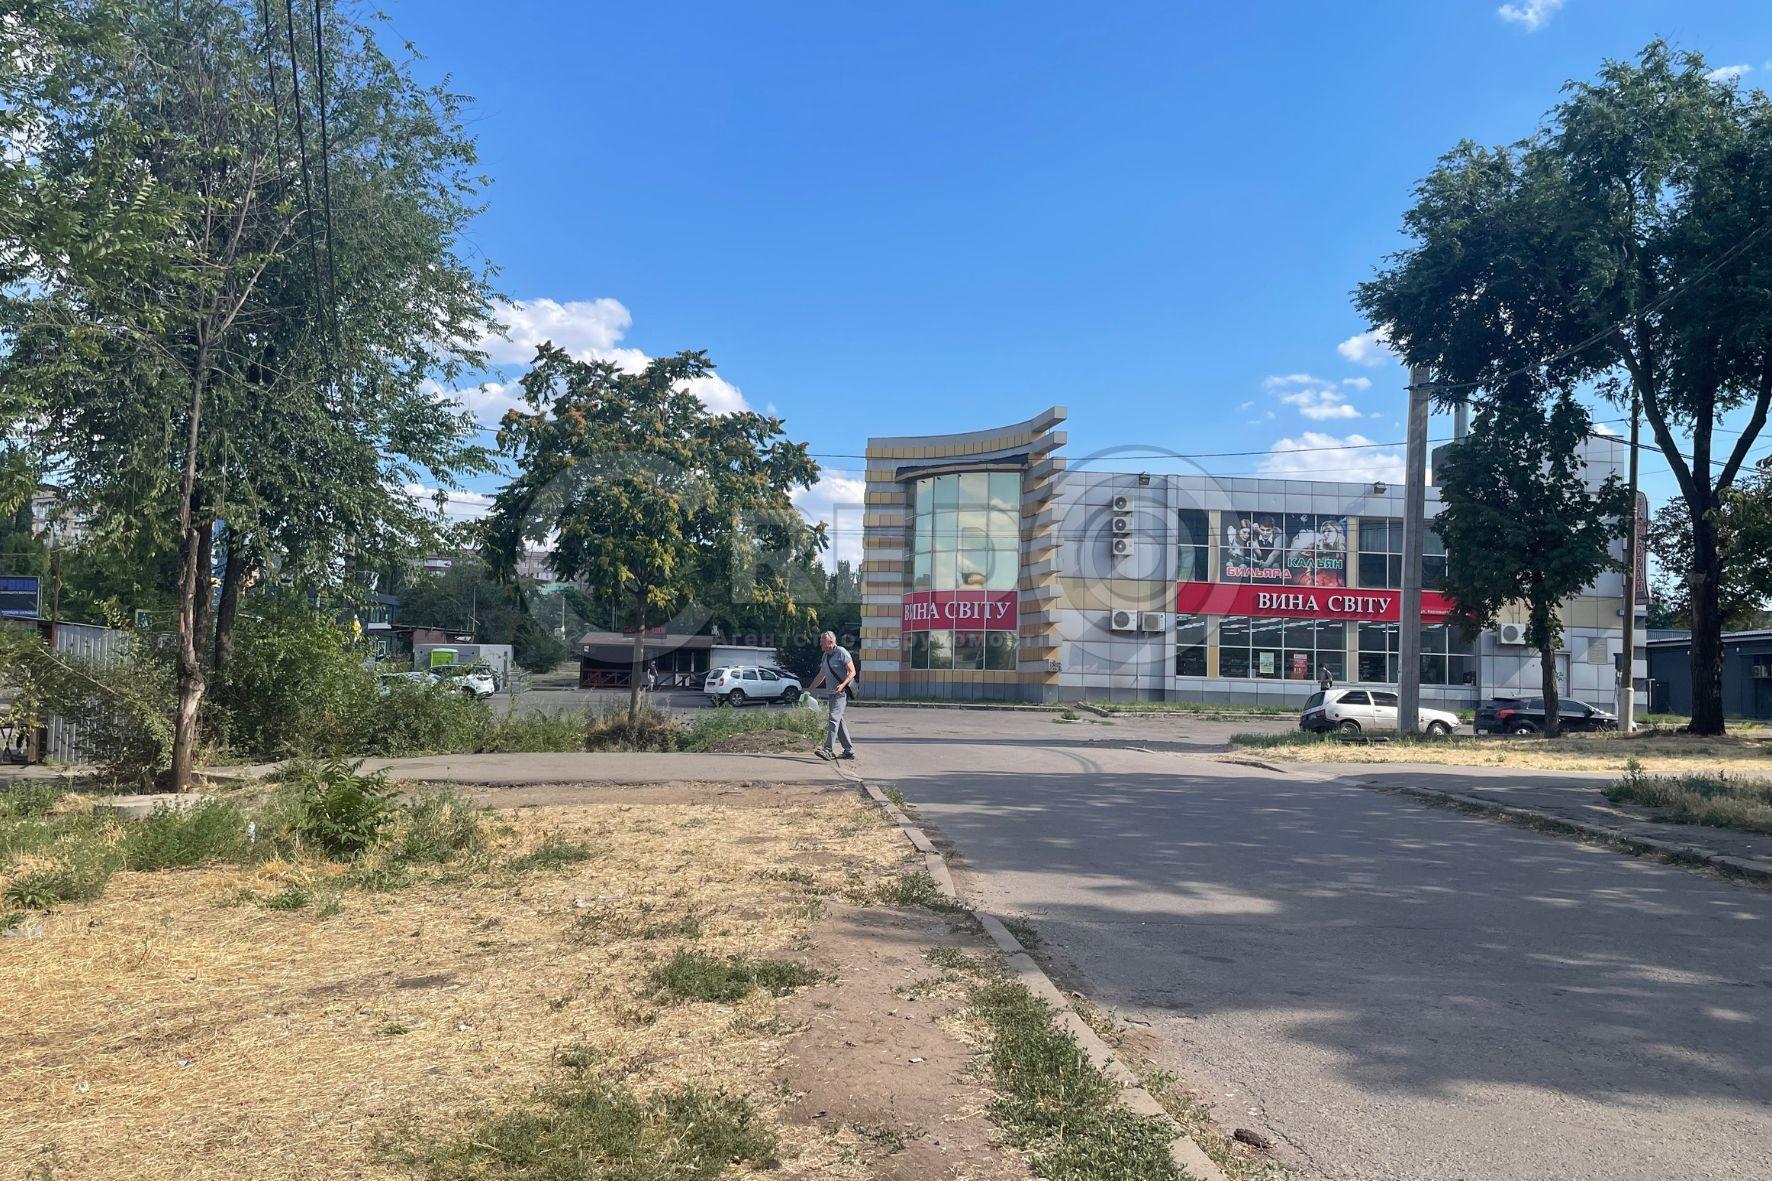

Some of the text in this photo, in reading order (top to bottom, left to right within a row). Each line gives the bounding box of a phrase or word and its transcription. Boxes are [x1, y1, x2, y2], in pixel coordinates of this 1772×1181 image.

[1288, 558, 1342, 569] КАЛЬЯН
[1226, 567, 1292, 578] БИЛЬЯРД
[1258, 592, 1392, 614] ВИНА СВІТУ
[904, 601, 1011, 621] ВИНА СВІТУ
